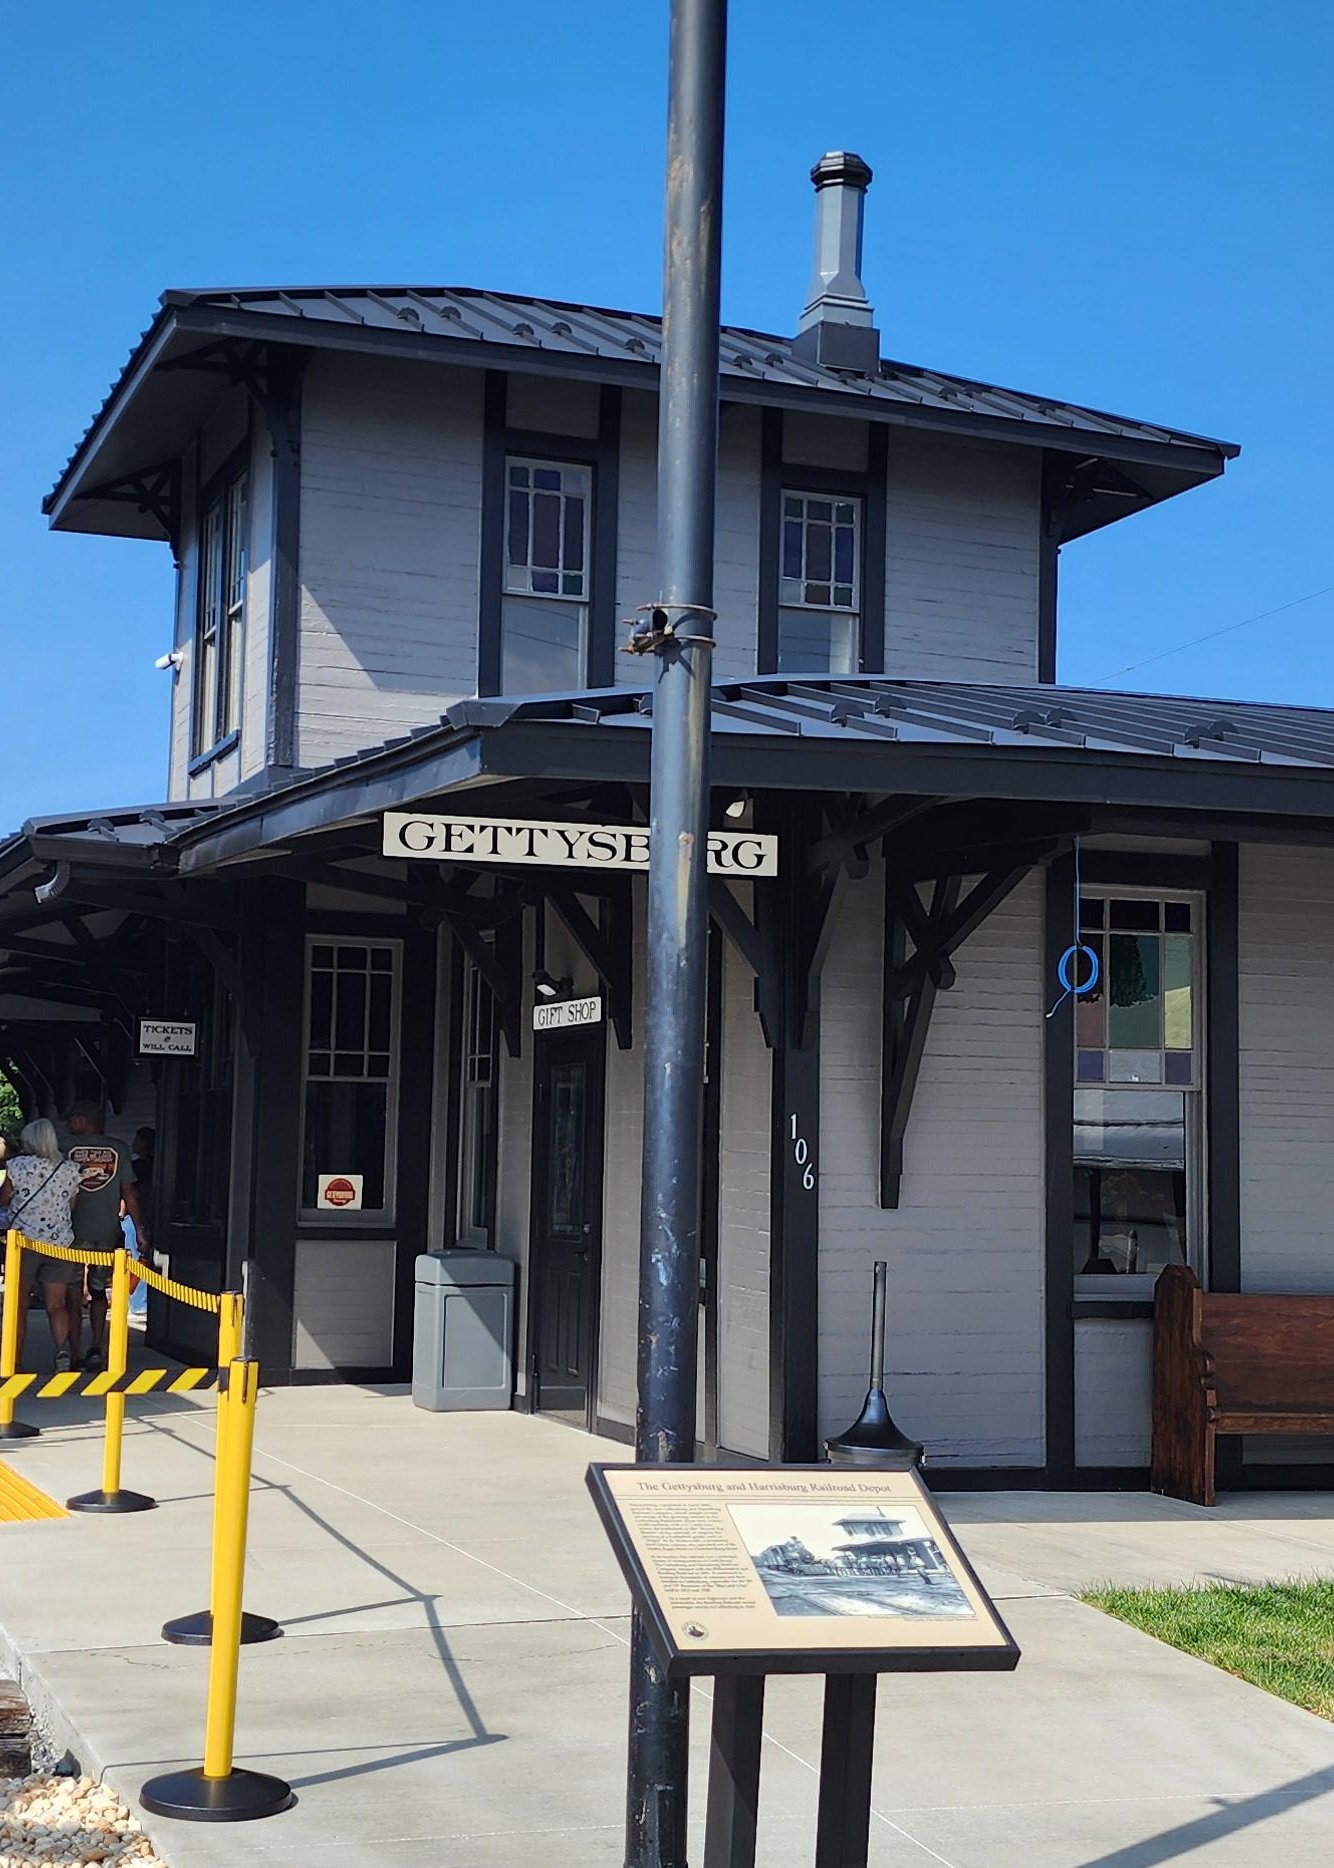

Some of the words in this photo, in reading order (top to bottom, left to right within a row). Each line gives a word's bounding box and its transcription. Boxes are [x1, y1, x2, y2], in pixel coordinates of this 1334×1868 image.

[399, 819, 768, 868] GETTYSBRG
[538, 1006, 563, 1026] GIFT
[568, 1001, 596, 1022] SHOP
[143, 1025, 193, 1035] TICKETS
[142, 1043, 166, 1051] WILL
[168, 1044, 192, 1052] CALL
[790, 1113, 814, 1189] 106
[637, 1482, 659, 1491] The
[662, 1482, 724, 1493] Gettysburg
[726, 1482, 746, 1492] and
[748, 1482, 808, 1494] Harrisburg
[811, 1483, 856, 1493] Railroad
[859, 1484, 891, 1495] Depot
